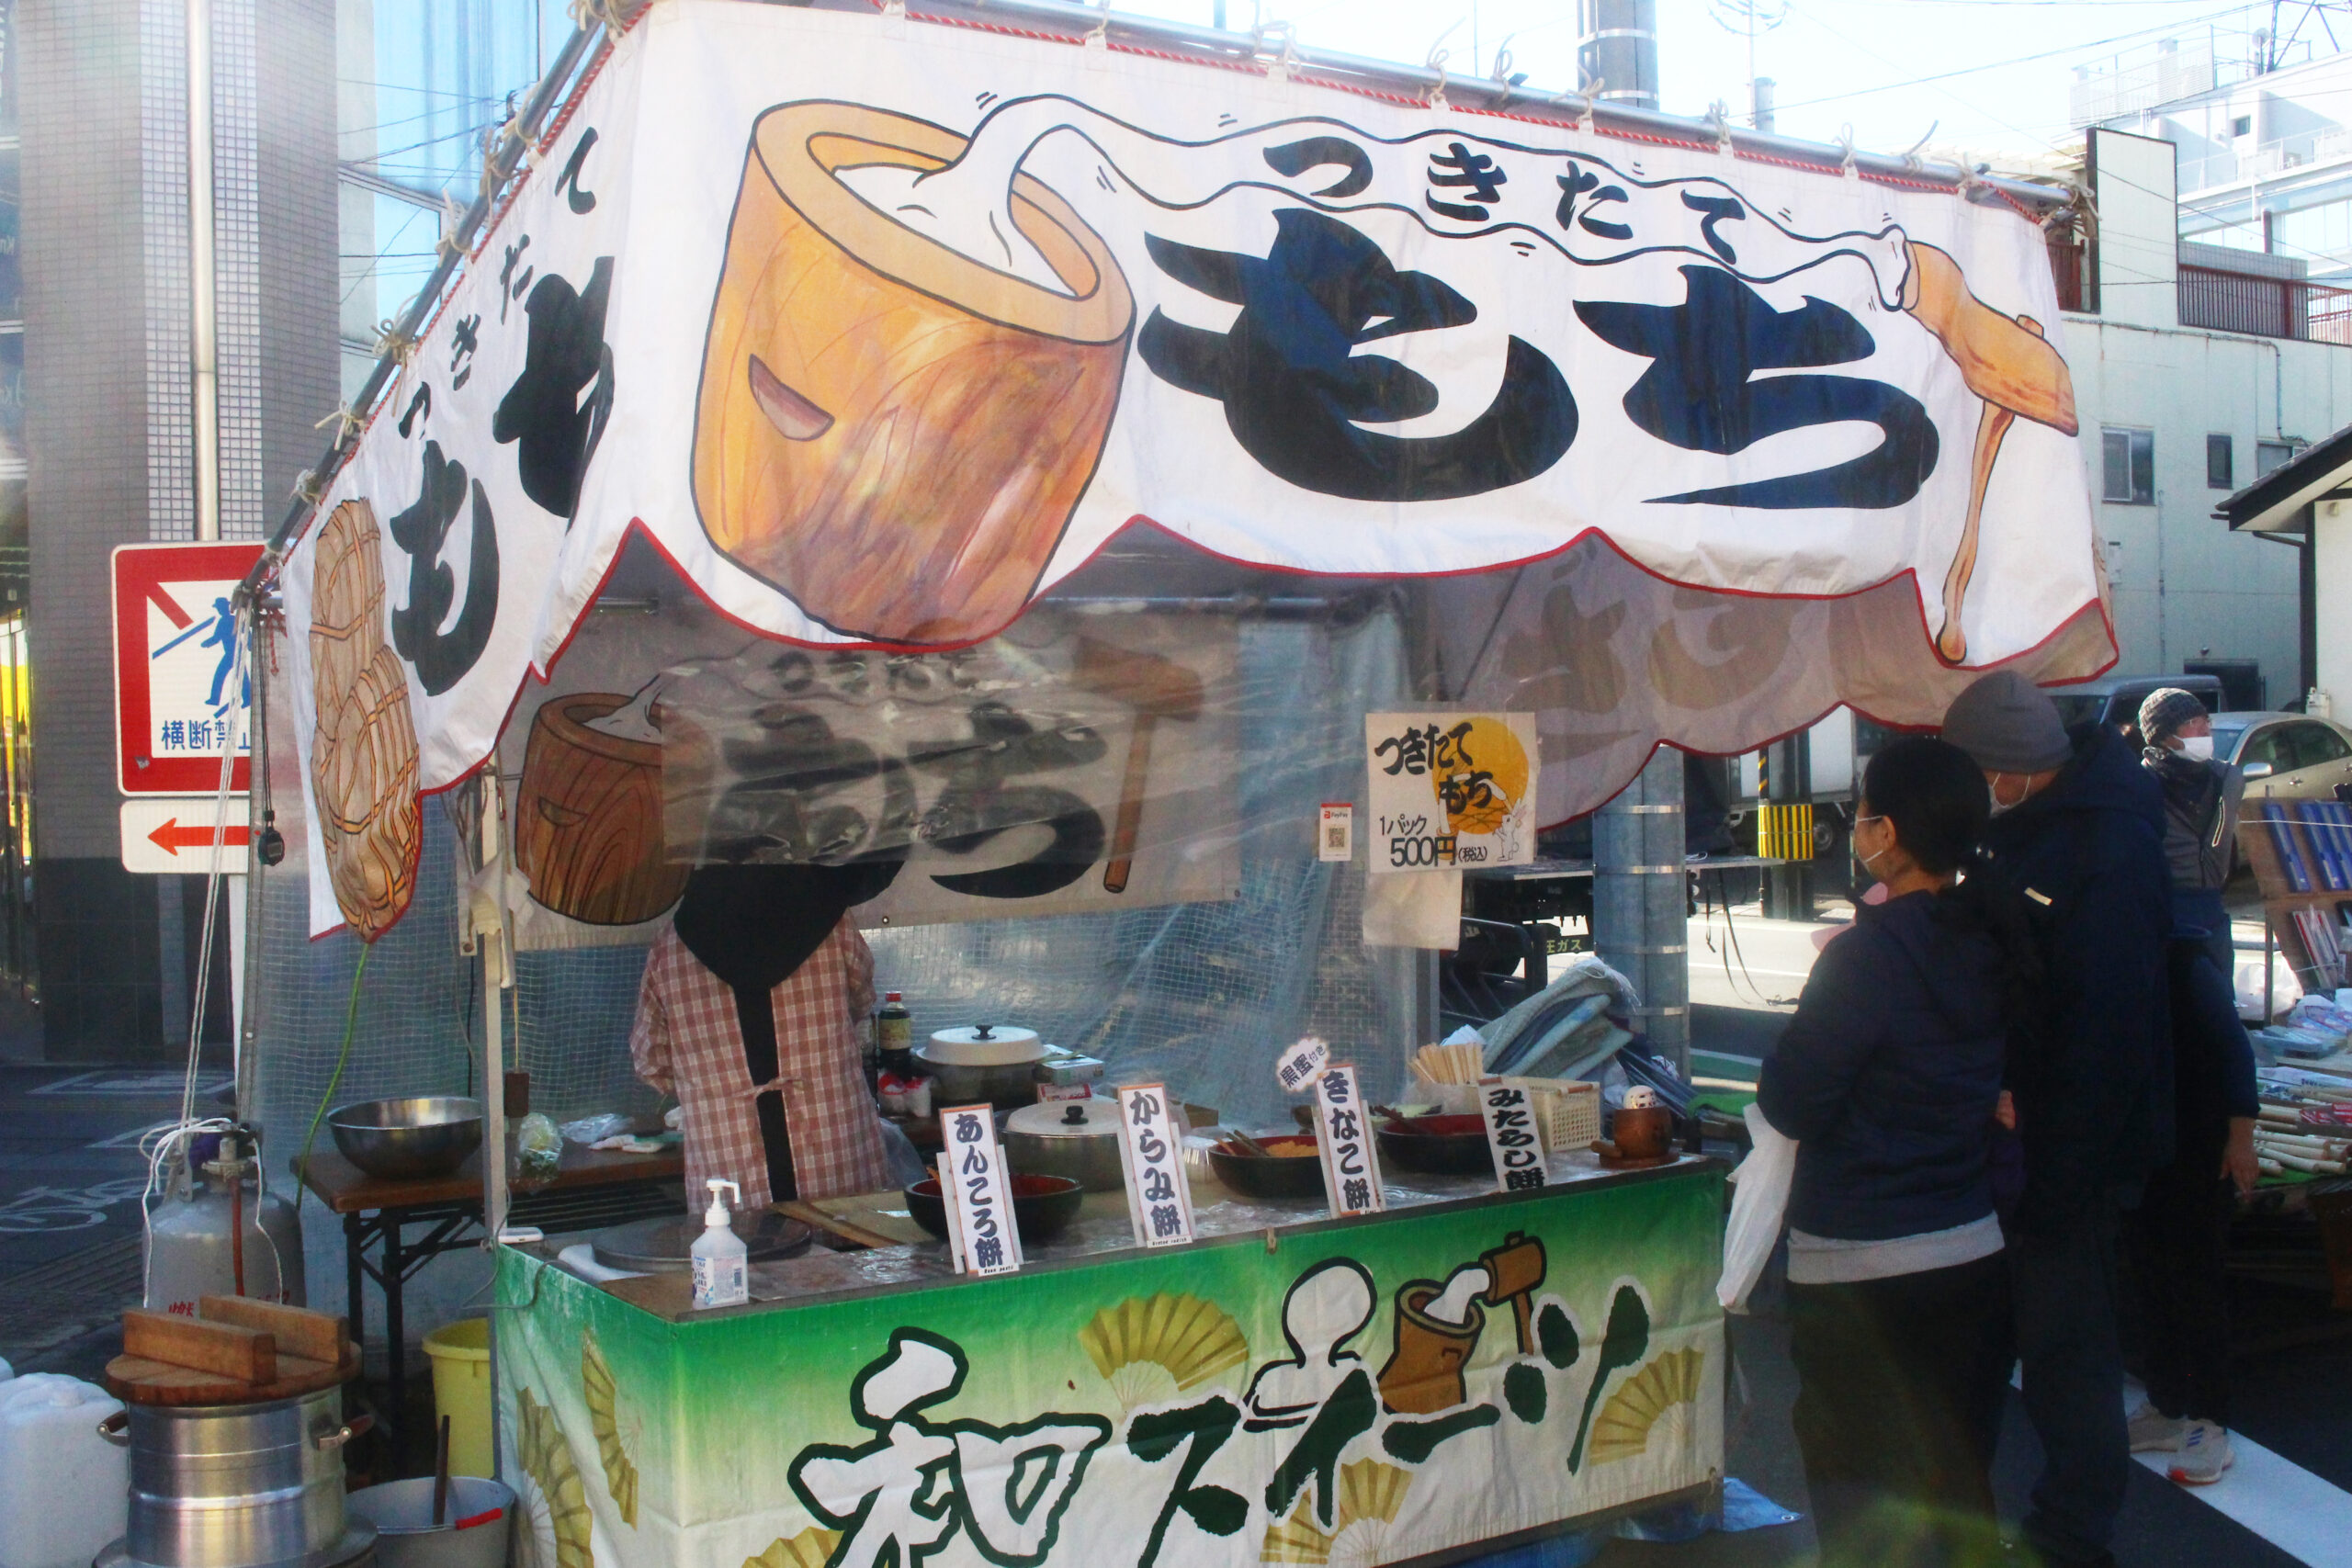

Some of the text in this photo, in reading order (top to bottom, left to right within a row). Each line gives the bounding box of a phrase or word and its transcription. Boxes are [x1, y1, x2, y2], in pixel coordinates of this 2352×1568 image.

[1262, 135, 1746, 265] つきたて
[399, 126, 598, 440] つきたて
[1137, 208, 1939, 509] もち
[1374, 722, 1474, 776] つきたて
[1439, 770, 1494, 815] もち
[1380, 814, 1428, 836] 1パック
[1280, 1044, 1327, 1089] 黒蜜付き
[954, 1113, 1003, 1269] あんころ餅
[1129, 1090, 1182, 1237] からみ餅
[1322, 1070, 1370, 1210] きなこ餅
[1487, 1089, 1545, 1190] みたらし餅
[787, 1273, 1650, 1568] 和スイーツ
